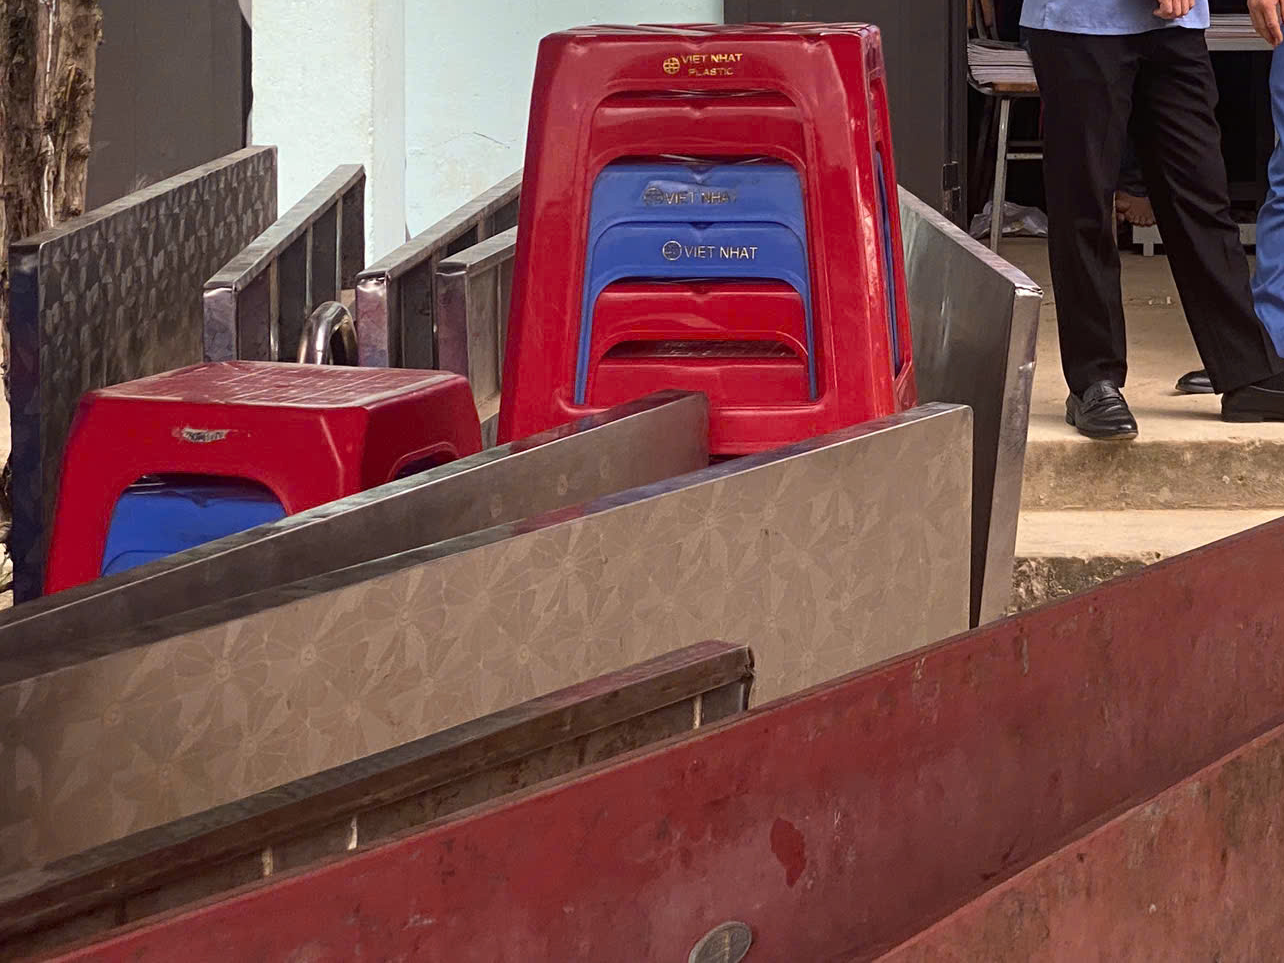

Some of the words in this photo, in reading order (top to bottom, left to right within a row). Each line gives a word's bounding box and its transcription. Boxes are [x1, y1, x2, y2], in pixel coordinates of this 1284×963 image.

[681, 53, 706, 64] VIET
[711, 53, 743, 63] NHAT
[688, 67, 734, 76] PLASTIC
[684, 245, 716, 260] VIET
[720, 246, 758, 260] NHAT
